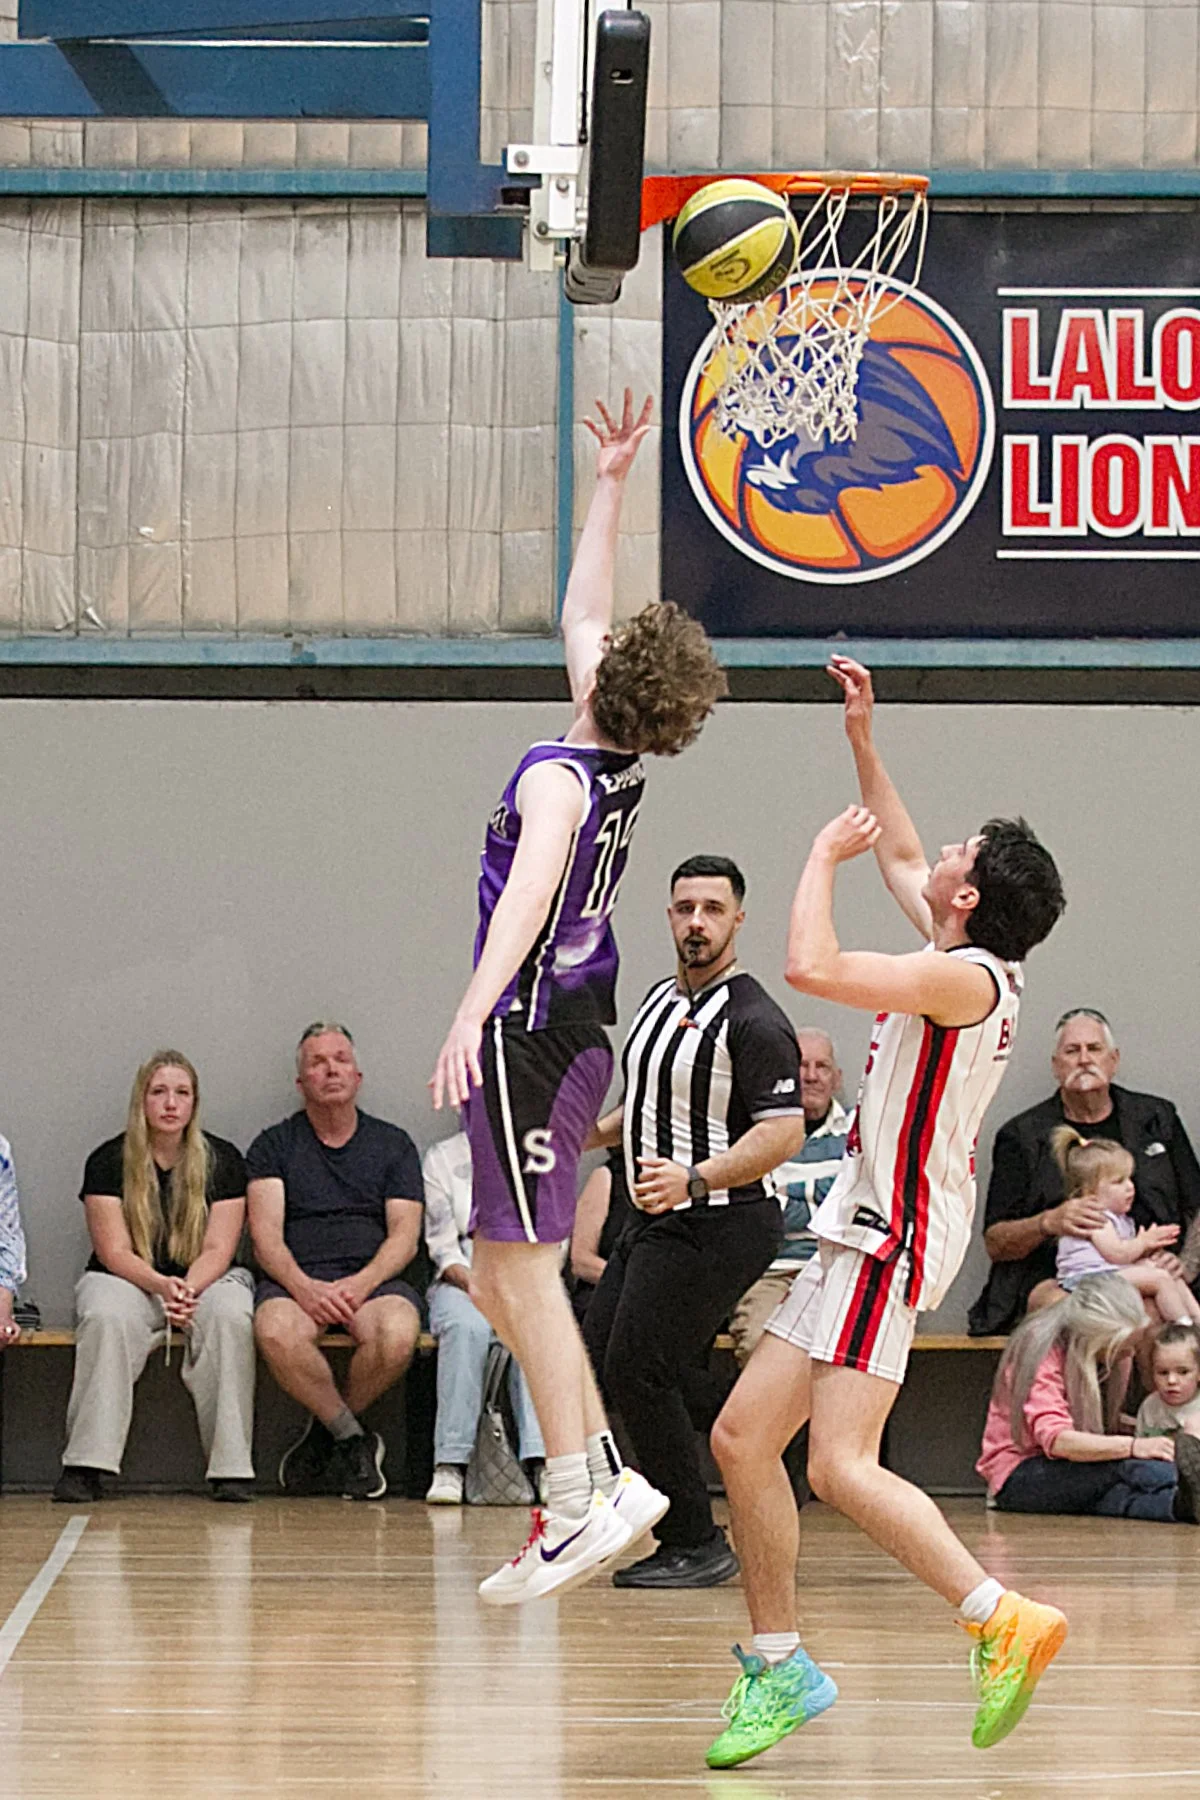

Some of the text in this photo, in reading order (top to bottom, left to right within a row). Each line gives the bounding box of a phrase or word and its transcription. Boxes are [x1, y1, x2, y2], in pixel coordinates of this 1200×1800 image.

[1003, 307, 1200, 410] LALO
[1003, 433, 1200, 537] LION
[523, 1128, 556, 1173] S
